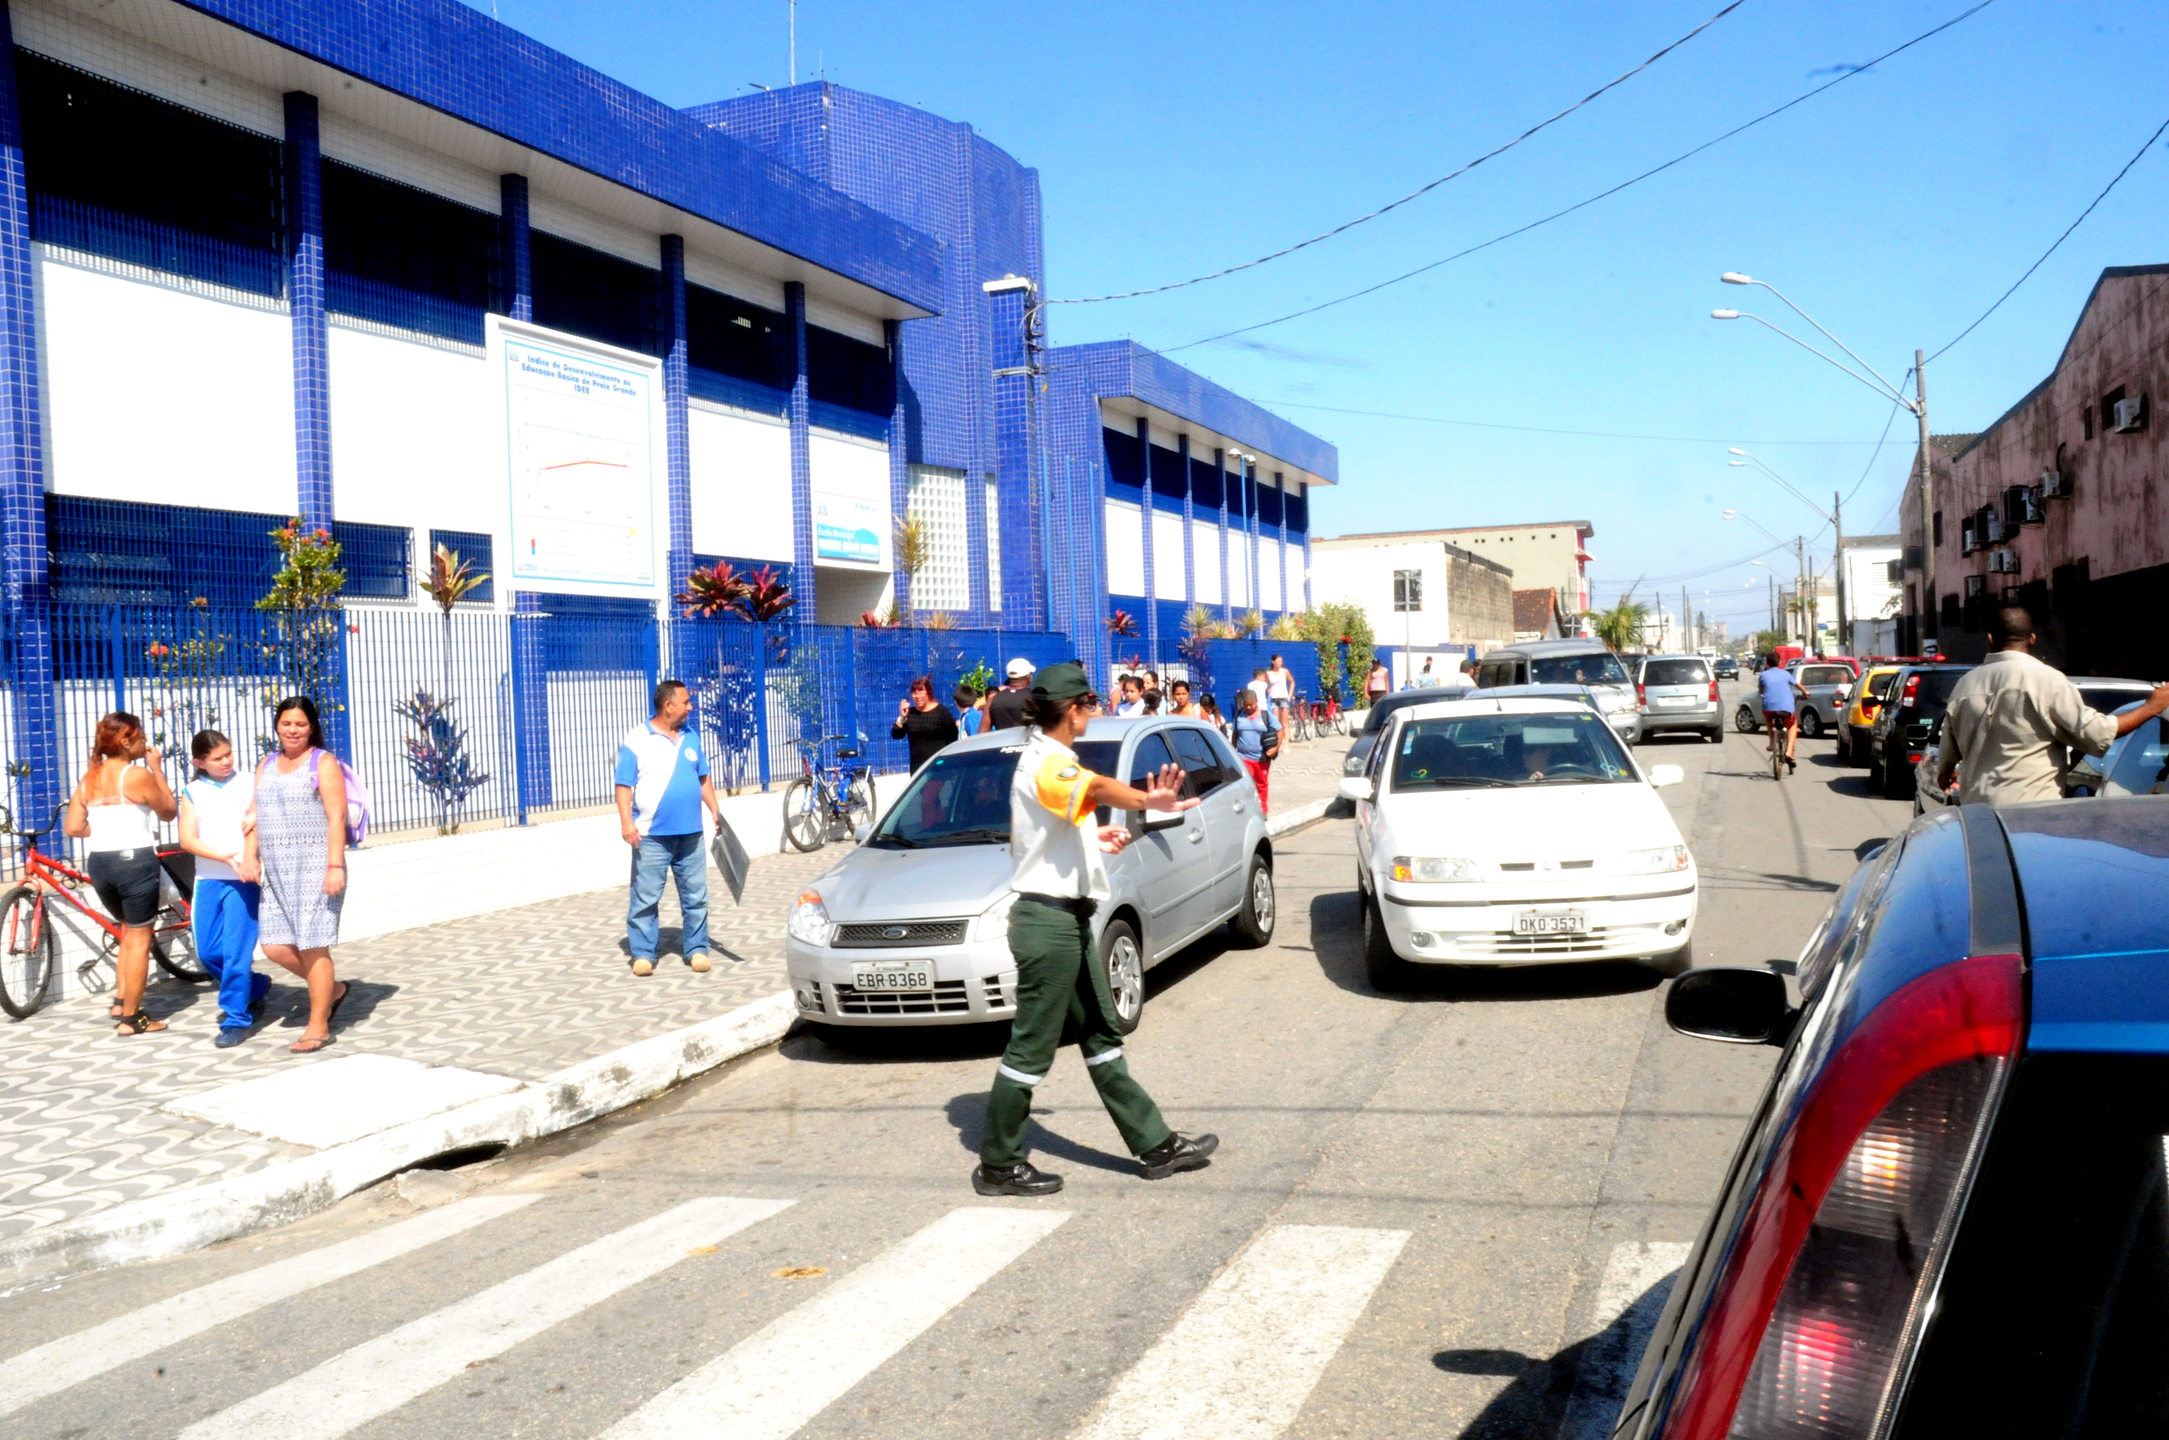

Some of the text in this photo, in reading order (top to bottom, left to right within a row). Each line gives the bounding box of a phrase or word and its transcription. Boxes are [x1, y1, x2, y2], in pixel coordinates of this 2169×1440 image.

[552, 361, 561, 370] de
[573, 384, 591, 395] IDEB
[582, 377, 590, 386] de
[612, 384, 636, 396] Grande
[857, 972, 927, 988] EBR-8368
